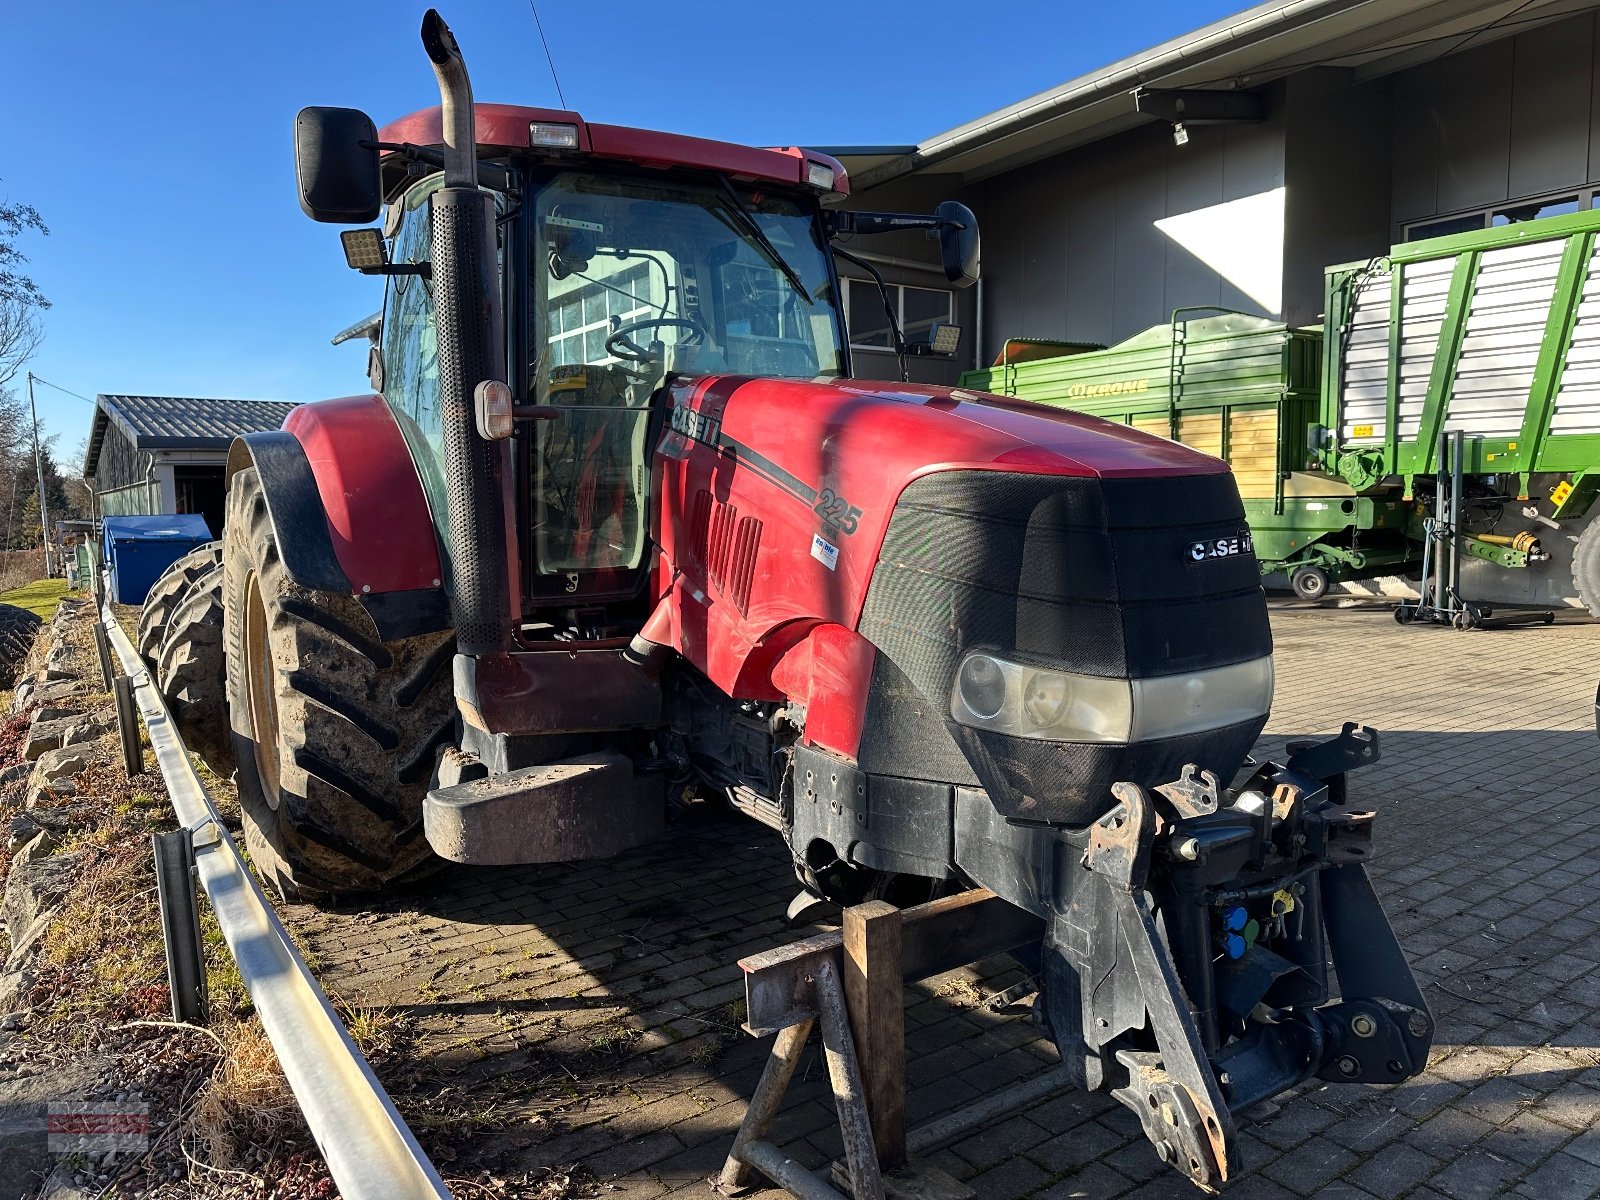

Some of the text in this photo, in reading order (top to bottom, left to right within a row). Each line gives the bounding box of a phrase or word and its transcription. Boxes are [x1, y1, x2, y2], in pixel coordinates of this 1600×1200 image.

[1086, 380, 1149, 397] KRONE
[671, 404, 704, 440] CASE
[813, 488, 863, 535] 225
[1191, 539, 1239, 560] CASE
